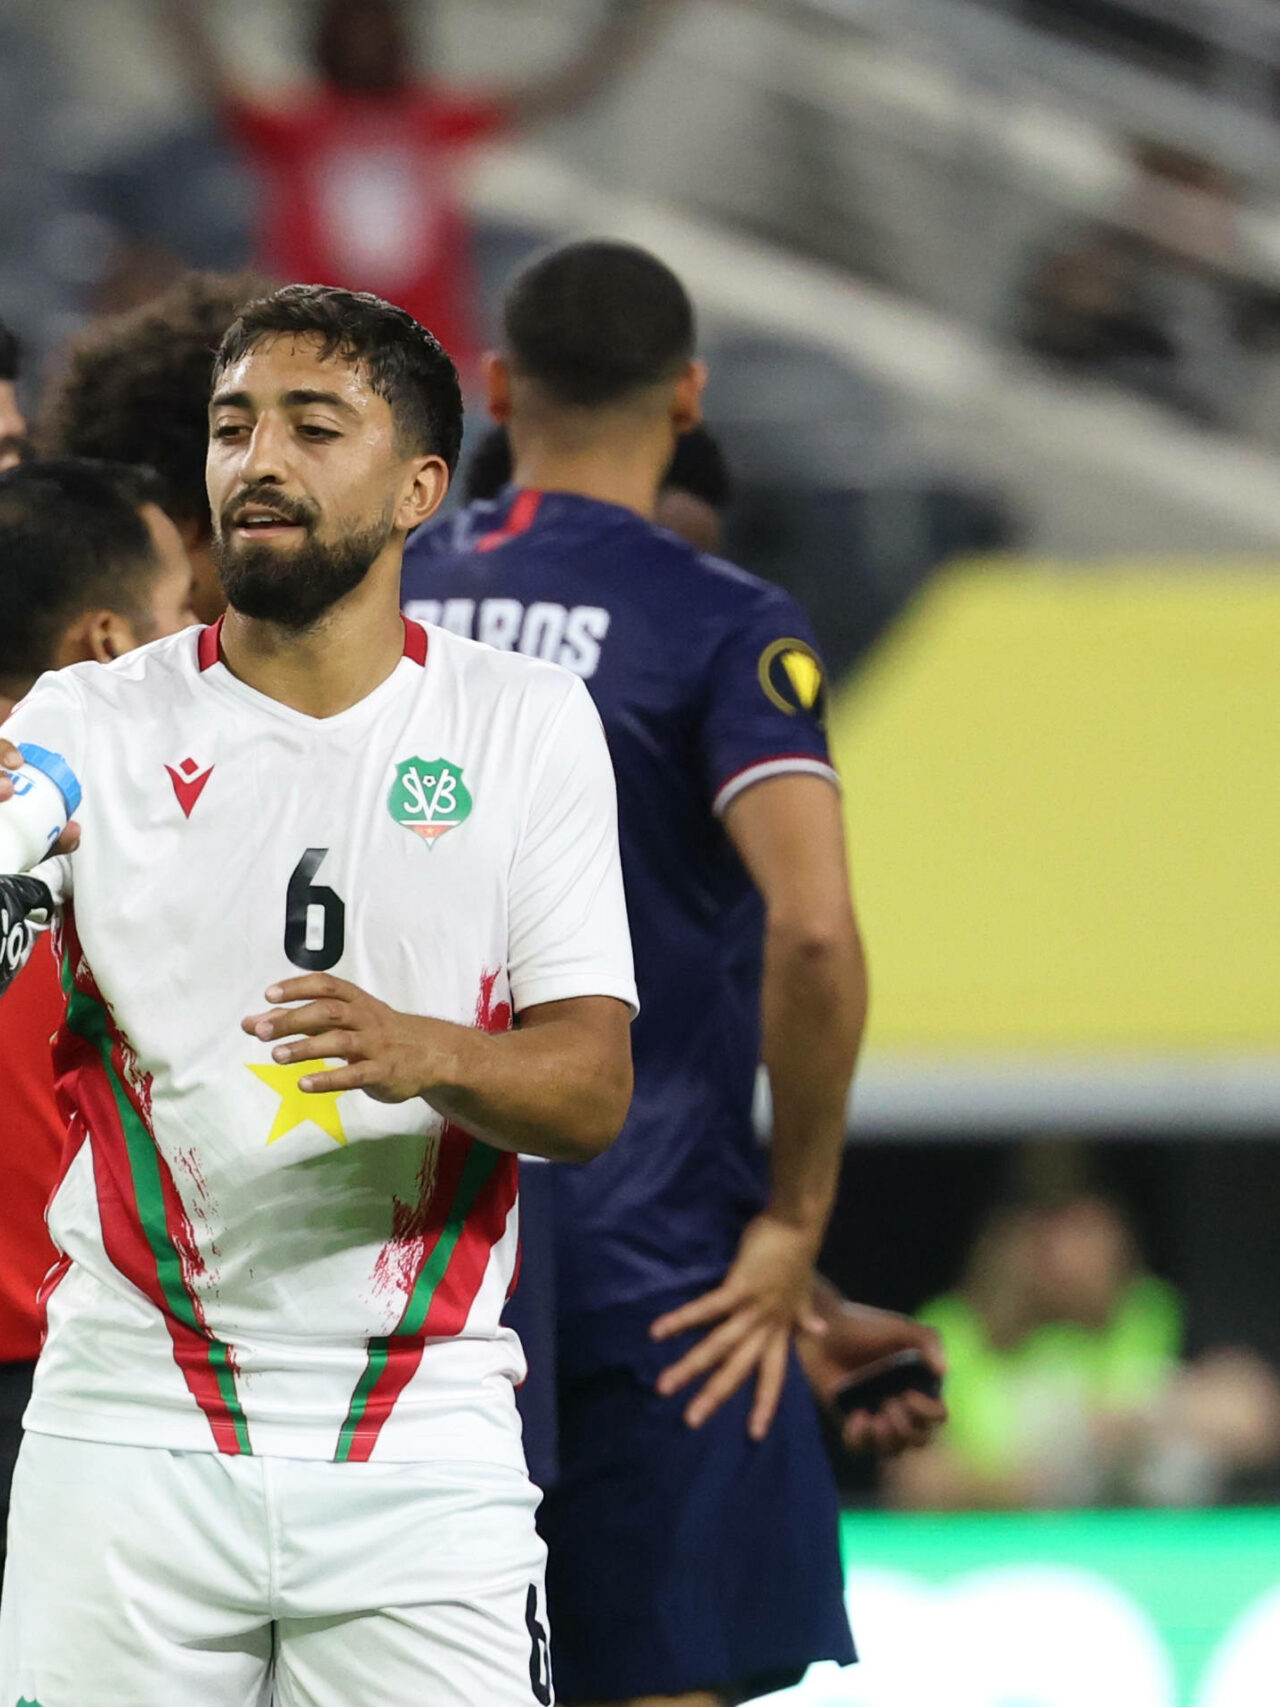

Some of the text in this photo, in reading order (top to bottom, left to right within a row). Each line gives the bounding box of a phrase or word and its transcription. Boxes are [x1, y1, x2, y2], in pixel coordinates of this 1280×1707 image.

[403, 598, 610, 679] AROS
[284, 848, 345, 972] 6
[525, 1582, 551, 1707] 6
